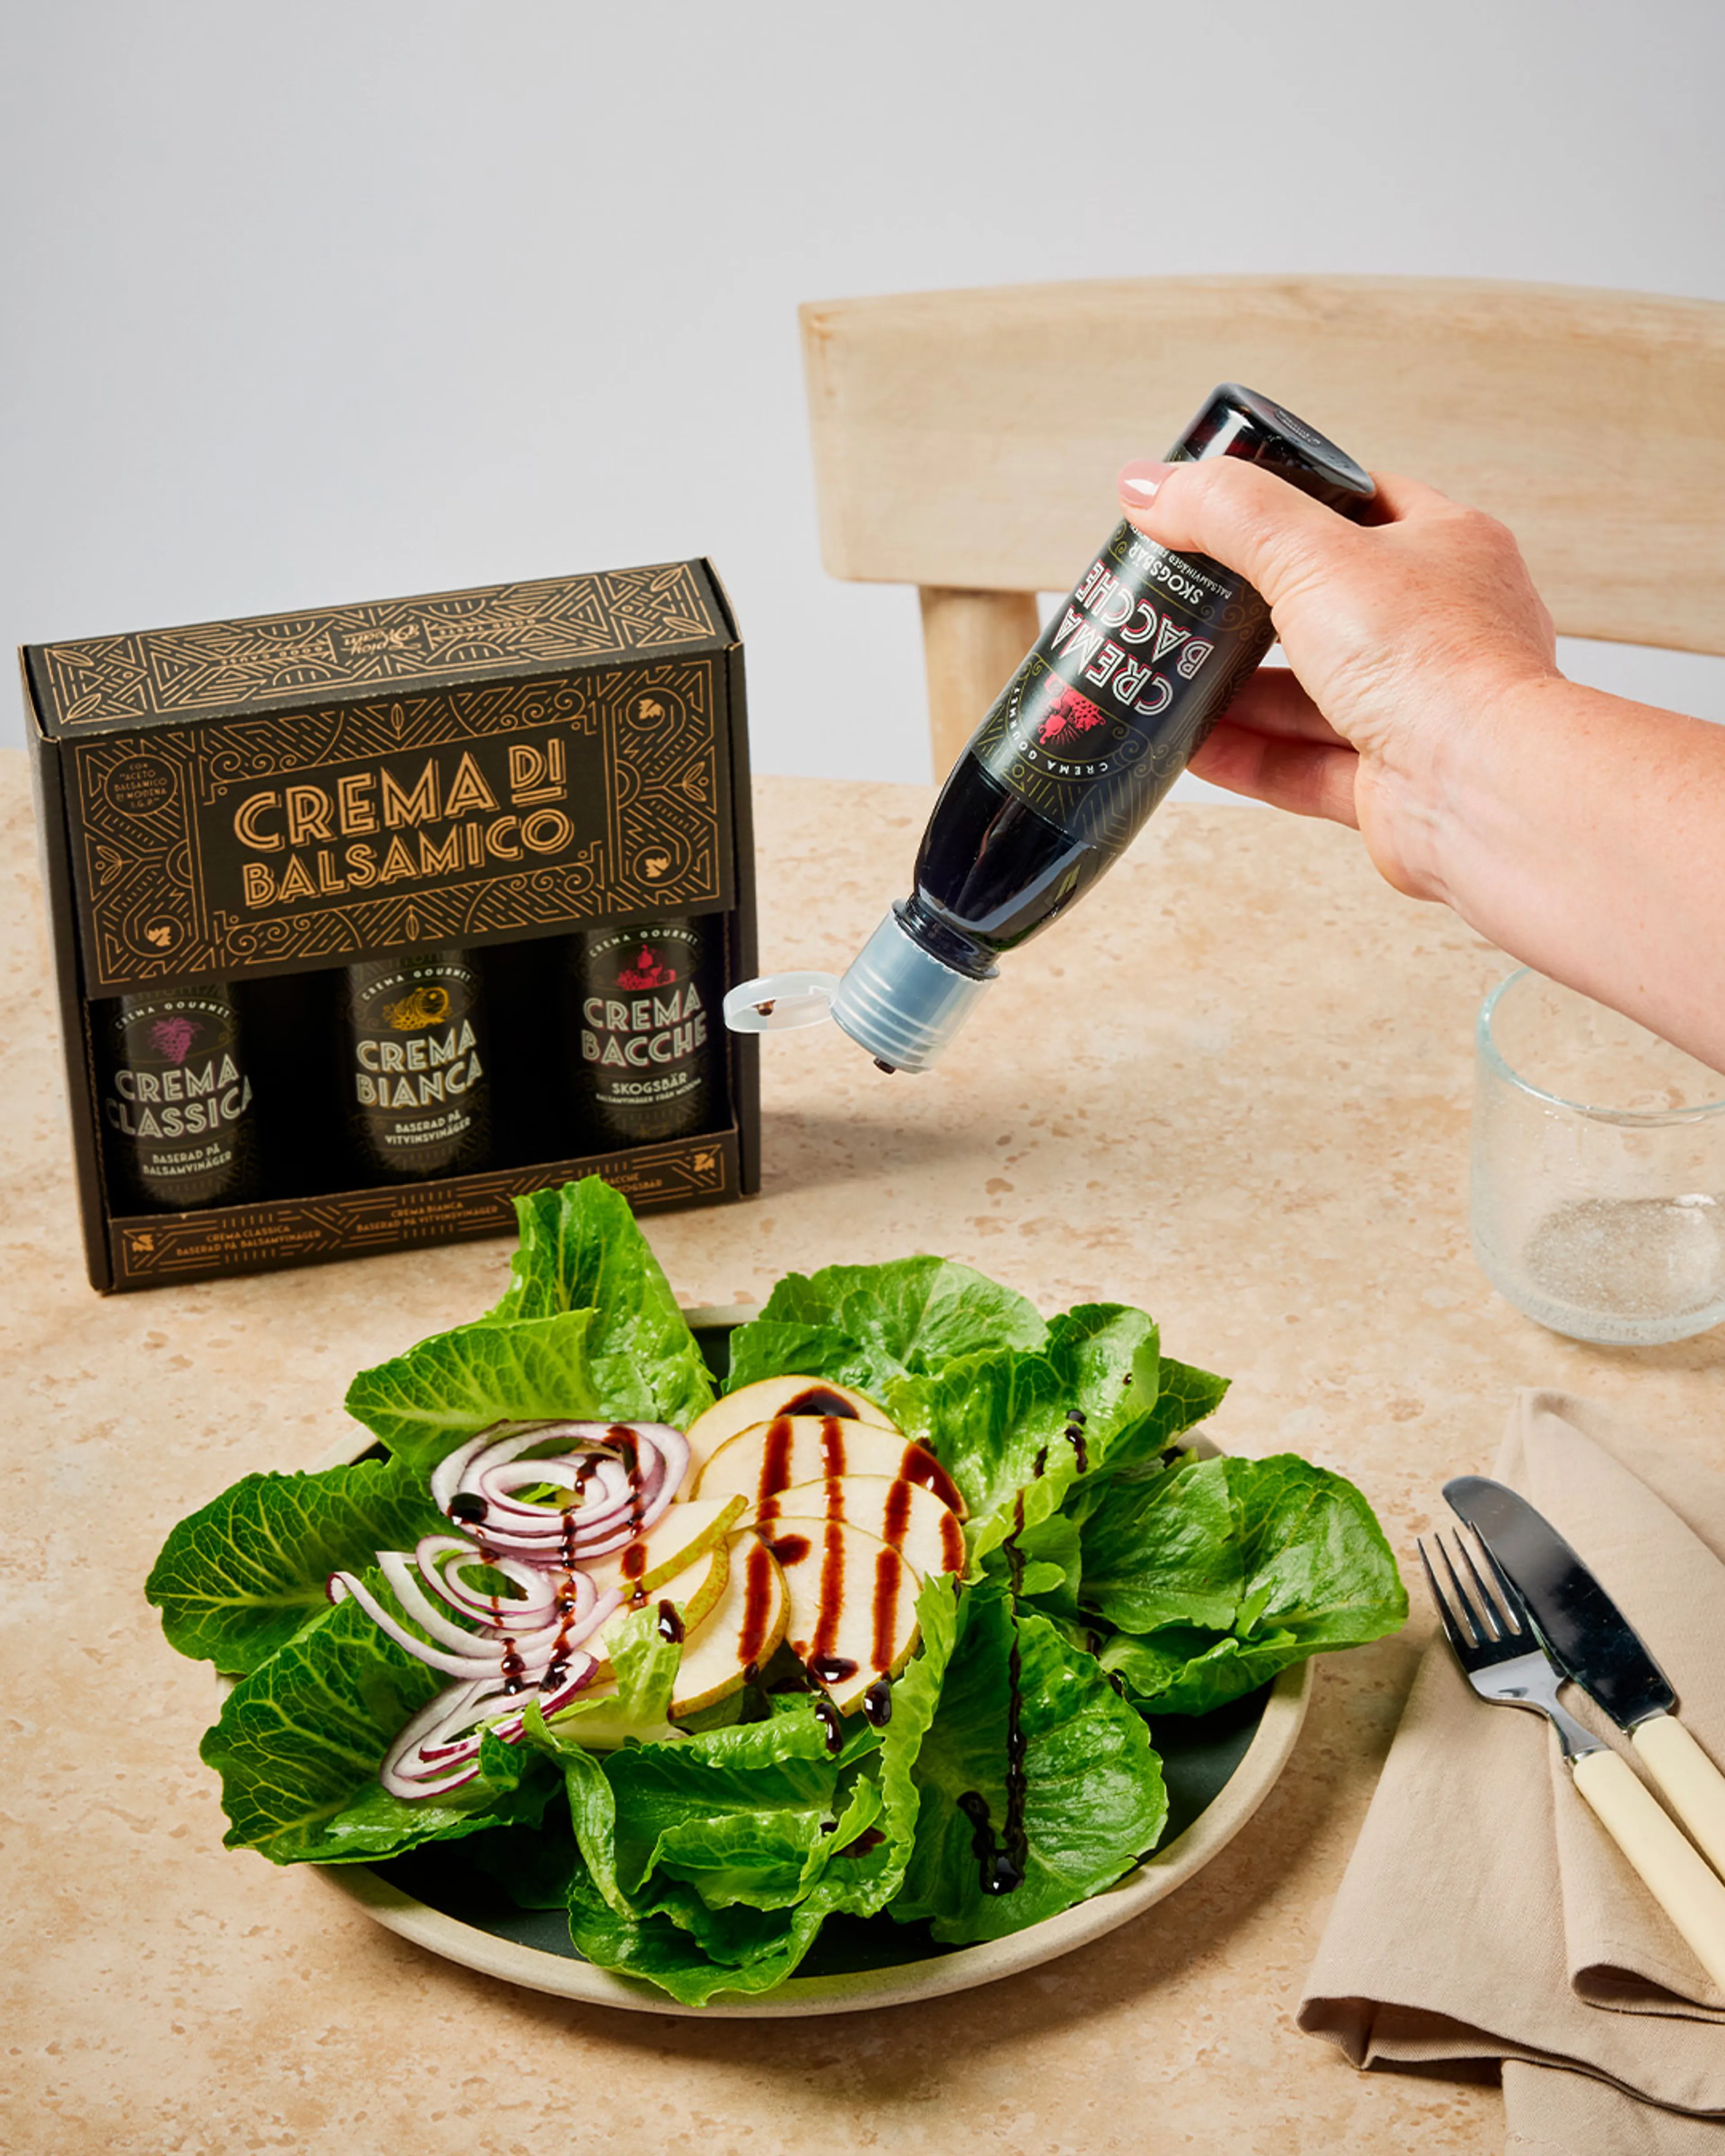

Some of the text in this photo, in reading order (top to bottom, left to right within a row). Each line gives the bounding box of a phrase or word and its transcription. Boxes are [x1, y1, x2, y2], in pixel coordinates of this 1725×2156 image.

[1128, 541, 1204, 606] SKOGSBÄR
[1075, 559, 1214, 680] BACCHE
[1050, 604, 1173, 716] CREMA
[1047, 760, 1108, 776] CREMA
[233, 738, 567, 853] CREMA DI
[243, 808, 575, 910] BALSAMICO
[589, 929, 699, 958] CREMA GOURMET
[361, 967, 472, 1002] CREMA GOURMET
[115, 1001, 231, 1030] CREMA GOURMET
[583, 982, 703, 1032] CREMA
[356, 1019, 478, 1073] CREMA
[581, 1011, 708, 1068] BACCHE
[115, 1053, 240, 1104] CREMA
[355, 1050, 484, 1109] BIANCA
[611, 1071, 688, 1096] SKOGSBÄR
[385, 1116, 472, 1145] VITVINSVINÄGER
[395, 1109, 461, 1134] BASERAD PÅ
[143, 1151, 232, 1176] BALSAMVINÄGER
[152, 1142, 221, 1164] BASERAD PÅ
[391, 1201, 464, 1219] CREMA BIANCA
[205, 1224, 291, 1243] CREMA CLASSICA
[356, 1219, 401, 1233] BASERAD
[176, 1243, 222, 1257] BASERAD
[240, 1229, 322, 1249] BALSAMVINÄGER
